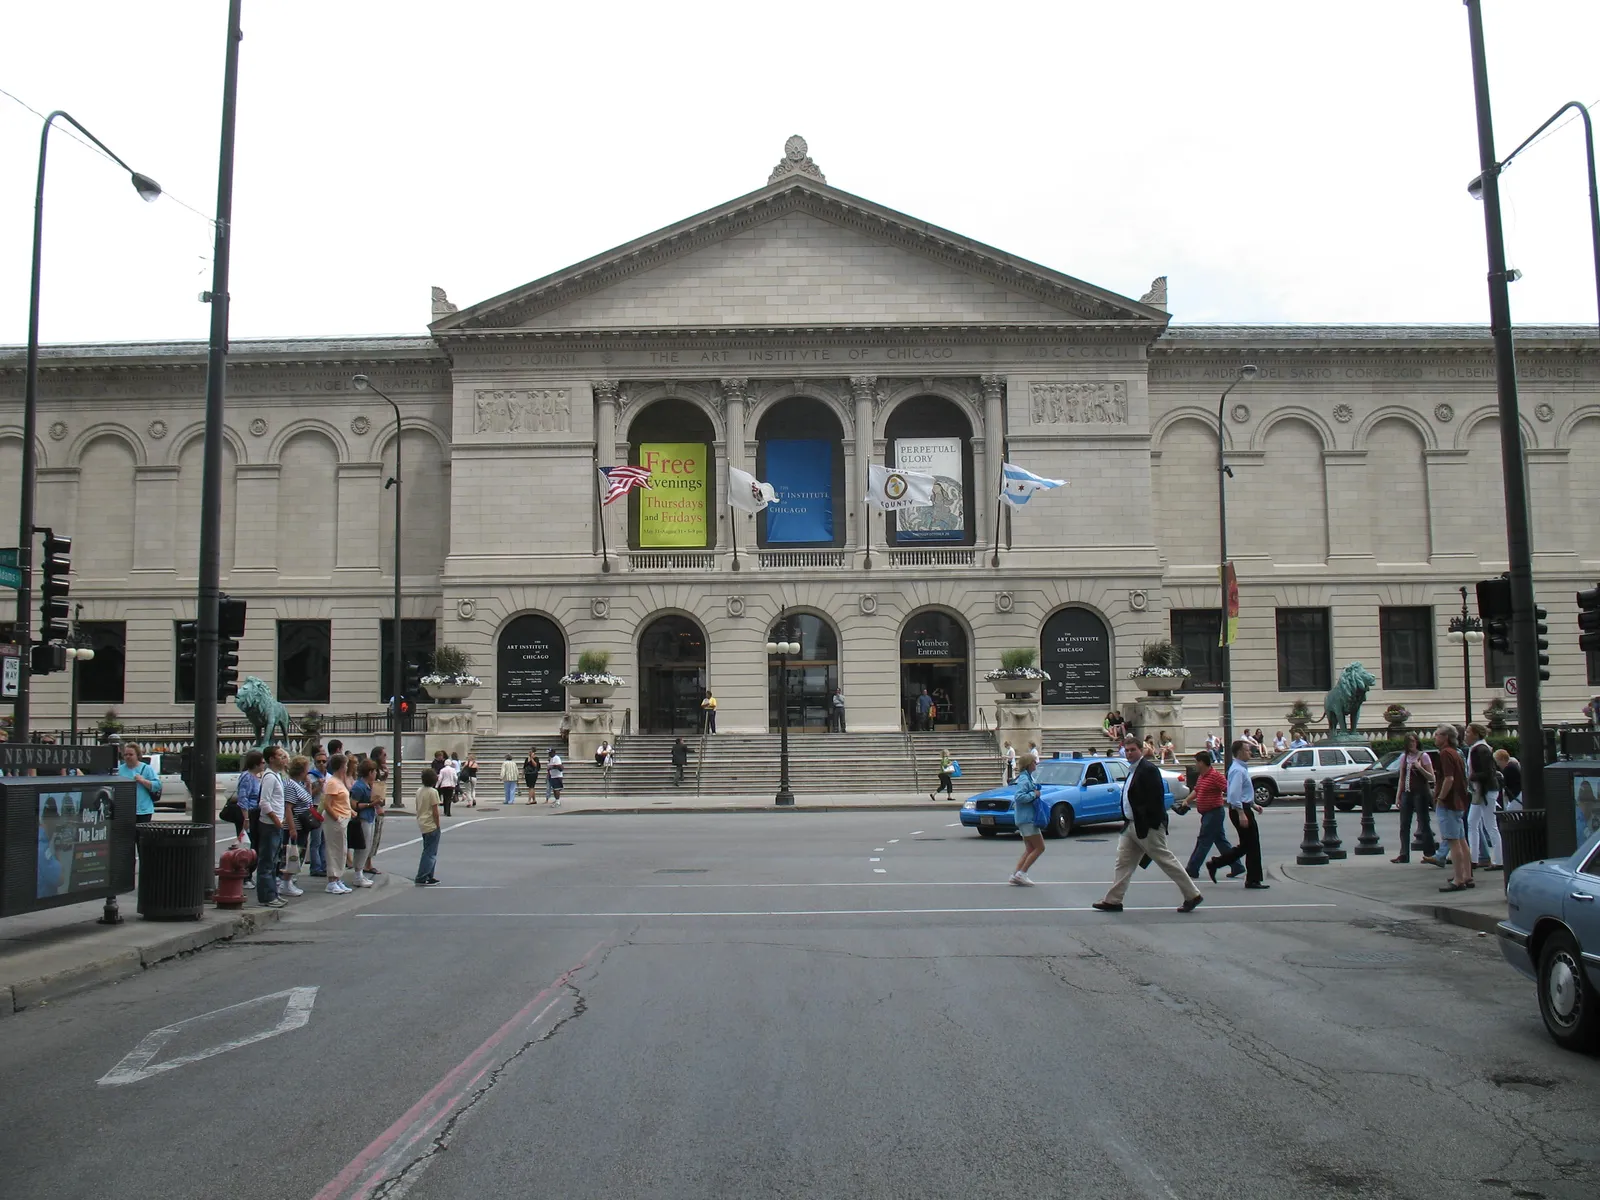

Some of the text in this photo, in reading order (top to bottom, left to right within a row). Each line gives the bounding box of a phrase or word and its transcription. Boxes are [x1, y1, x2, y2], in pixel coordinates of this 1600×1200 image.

[520, 353, 577, 365] DOMINI
[650, 347, 953, 363] THE ART INSTITVTE OF CHICAGO
[1150, 366, 1581, 379] TITIAN ANDRE DEL SARTO CORREGGIO HOLBEIN ERONESE
[170, 382, 208, 394] DVRE
[233, 379, 296, 393] MICHAEL
[304, 378, 353, 391] ANGEL
[382, 377, 449, 390] RAPHAEL
[901, 445, 957, 455] PERPETUAL
[644, 451, 697, 475] Free
[901, 455, 933, 463] GLORY
[646, 497, 704, 512] Thursdays
[880, 499, 913, 509] COUNTY
[644, 511, 703, 525] and Fridays
[0, 569, 16, 583] dams
[917, 639, 949, 647] Members
[918, 648, 949, 656] Entrance
[6, 660, 17, 670] ONE
[5, 671, 17, 680] WAY
[4, 748, 92, 765] NEWSPAPERS
[82, 808, 98, 825] Obey
[78, 826, 107, 843] The Law!
